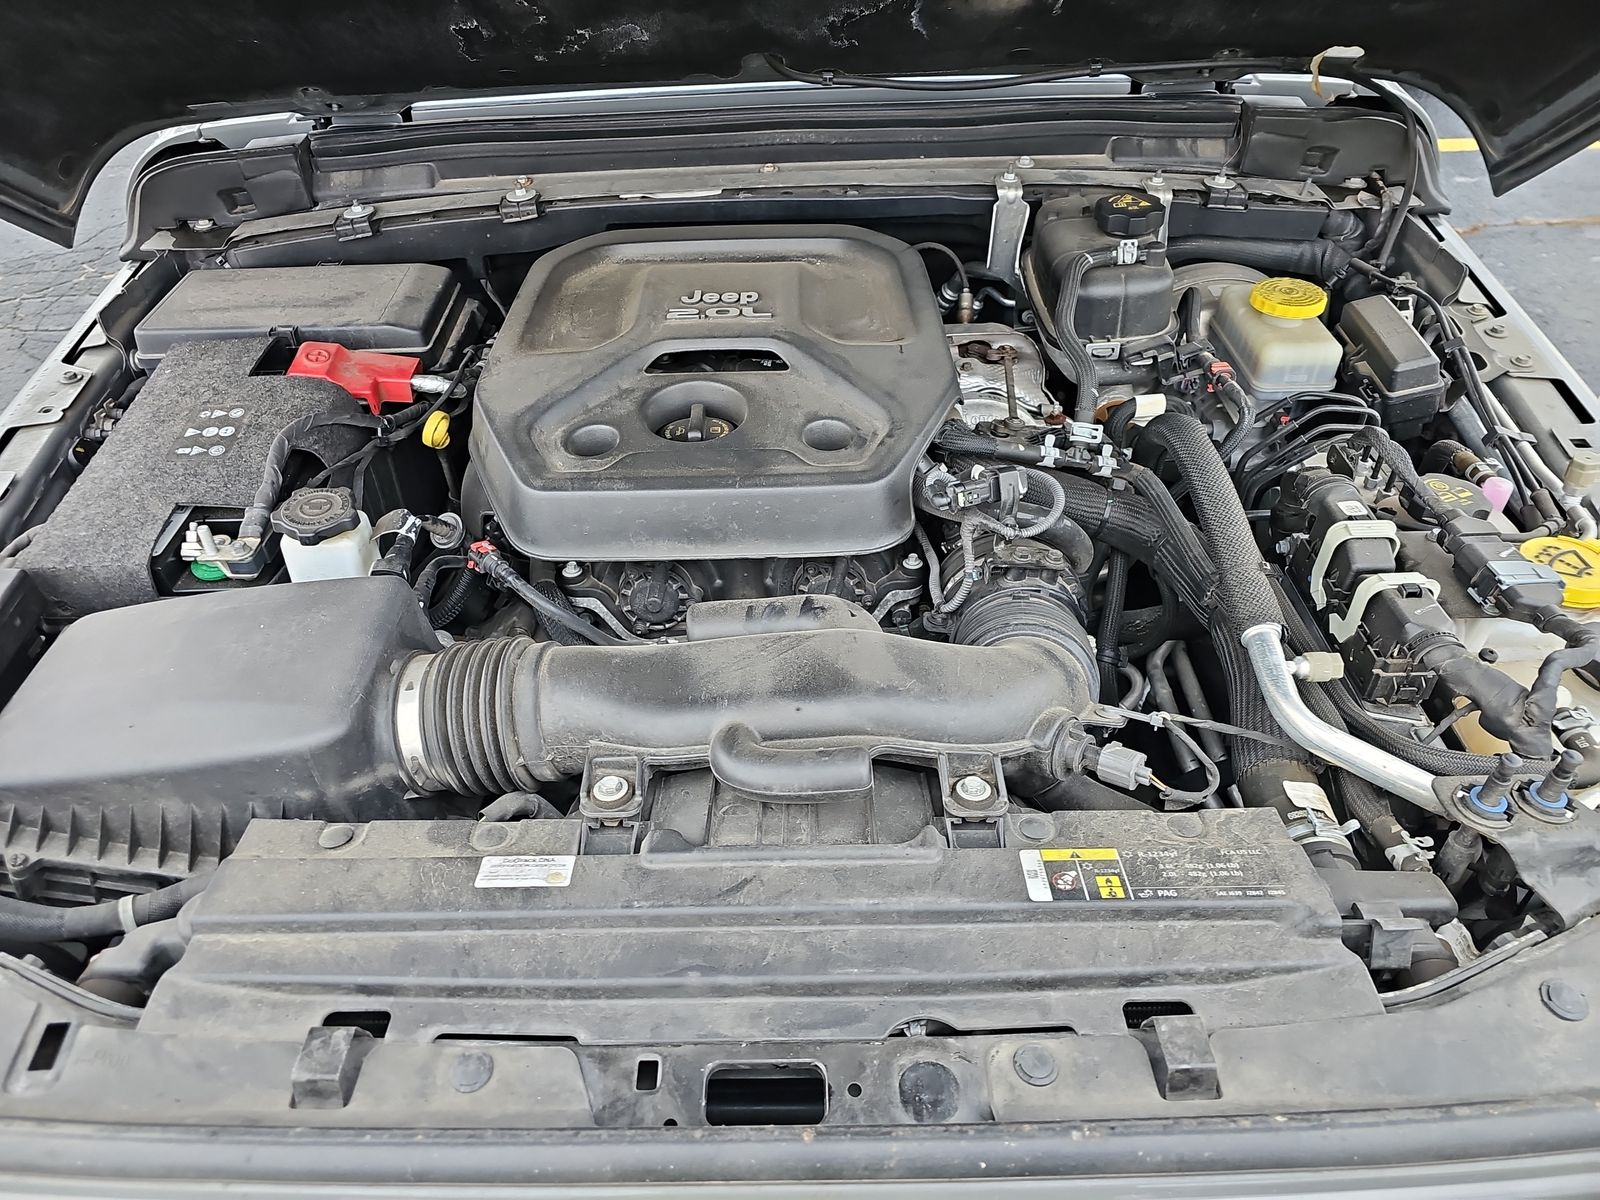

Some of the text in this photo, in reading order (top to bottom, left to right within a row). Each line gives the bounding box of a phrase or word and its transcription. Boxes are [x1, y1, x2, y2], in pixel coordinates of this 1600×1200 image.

[681, 289, 759, 305] Jeep
[666, 306, 773, 320] 2.0L
[1156, 889, 1178, 898] PAG
